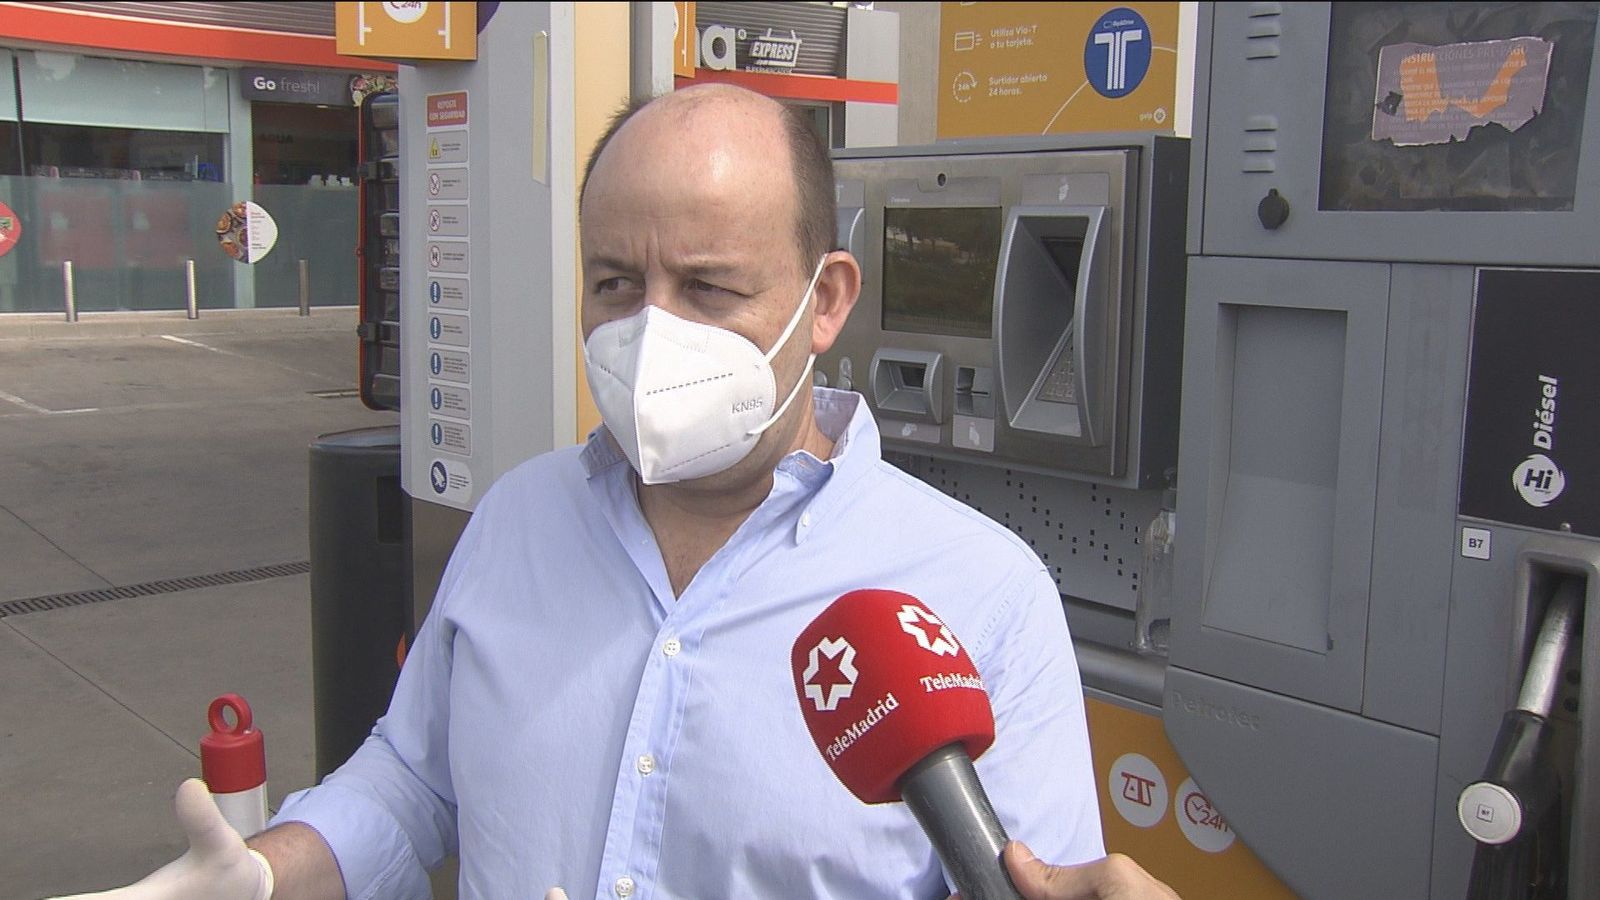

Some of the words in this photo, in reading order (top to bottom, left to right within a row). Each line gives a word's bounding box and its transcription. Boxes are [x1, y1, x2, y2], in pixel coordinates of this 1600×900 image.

[751, 41, 795, 60] EXPRESS
[253, 76, 276, 91] Go
[731, 398, 763, 414] KN95
[1533, 374, 1558, 450] Diésel
[1524, 468, 1553, 490] Hi
[1468, 538, 1483, 549] B7
[826, 692, 899, 761] TeleMadrid
